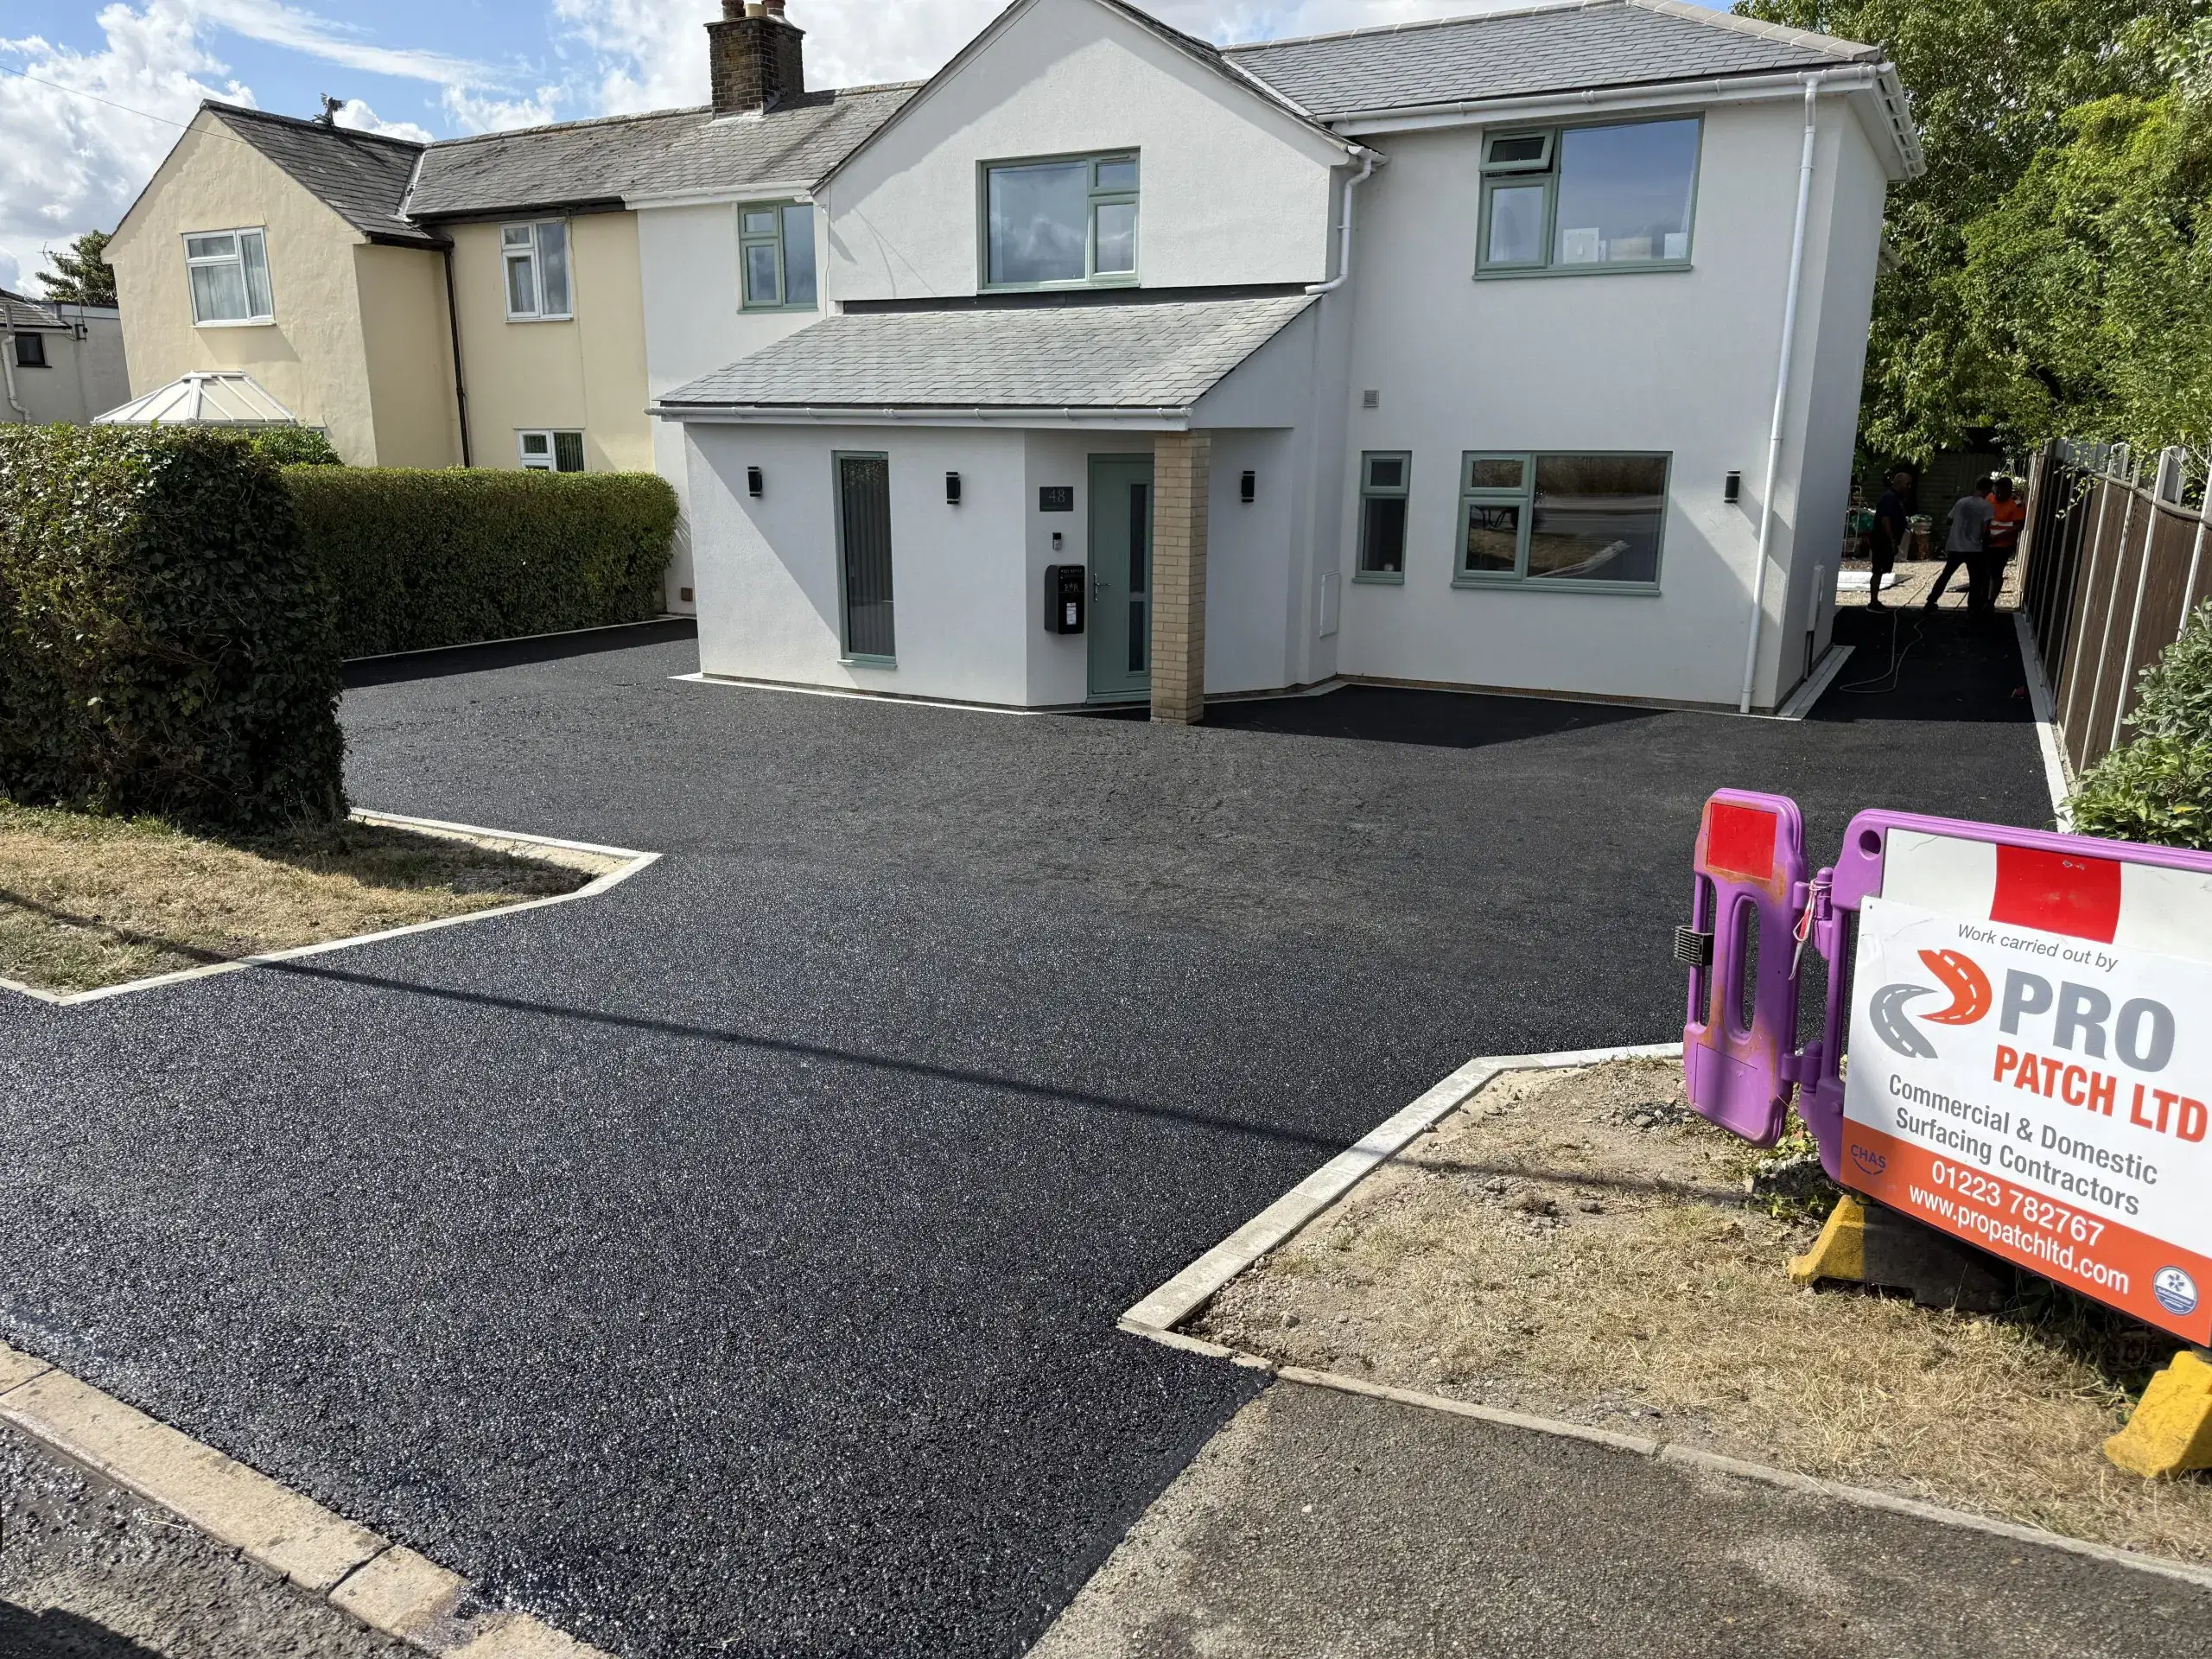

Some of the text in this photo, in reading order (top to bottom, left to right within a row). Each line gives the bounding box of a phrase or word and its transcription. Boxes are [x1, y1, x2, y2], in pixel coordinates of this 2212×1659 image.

[1048, 488, 1065, 503] 48
[1958, 924, 2119, 972] Work carried out by
[1999, 968, 2176, 1072] PRO
[1889, 1074, 2158, 1185] Commercial & Domestic
[1993, 1044, 2208, 1143] PATCH LTD
[1851, 1144, 1887, 1169] CHAS
[1897, 1107, 2139, 1216] Surfacing Contractors
[1932, 1160, 2105, 1247] 01223 782767
[1909, 1185, 2129, 1294] www.propatchltd.com
